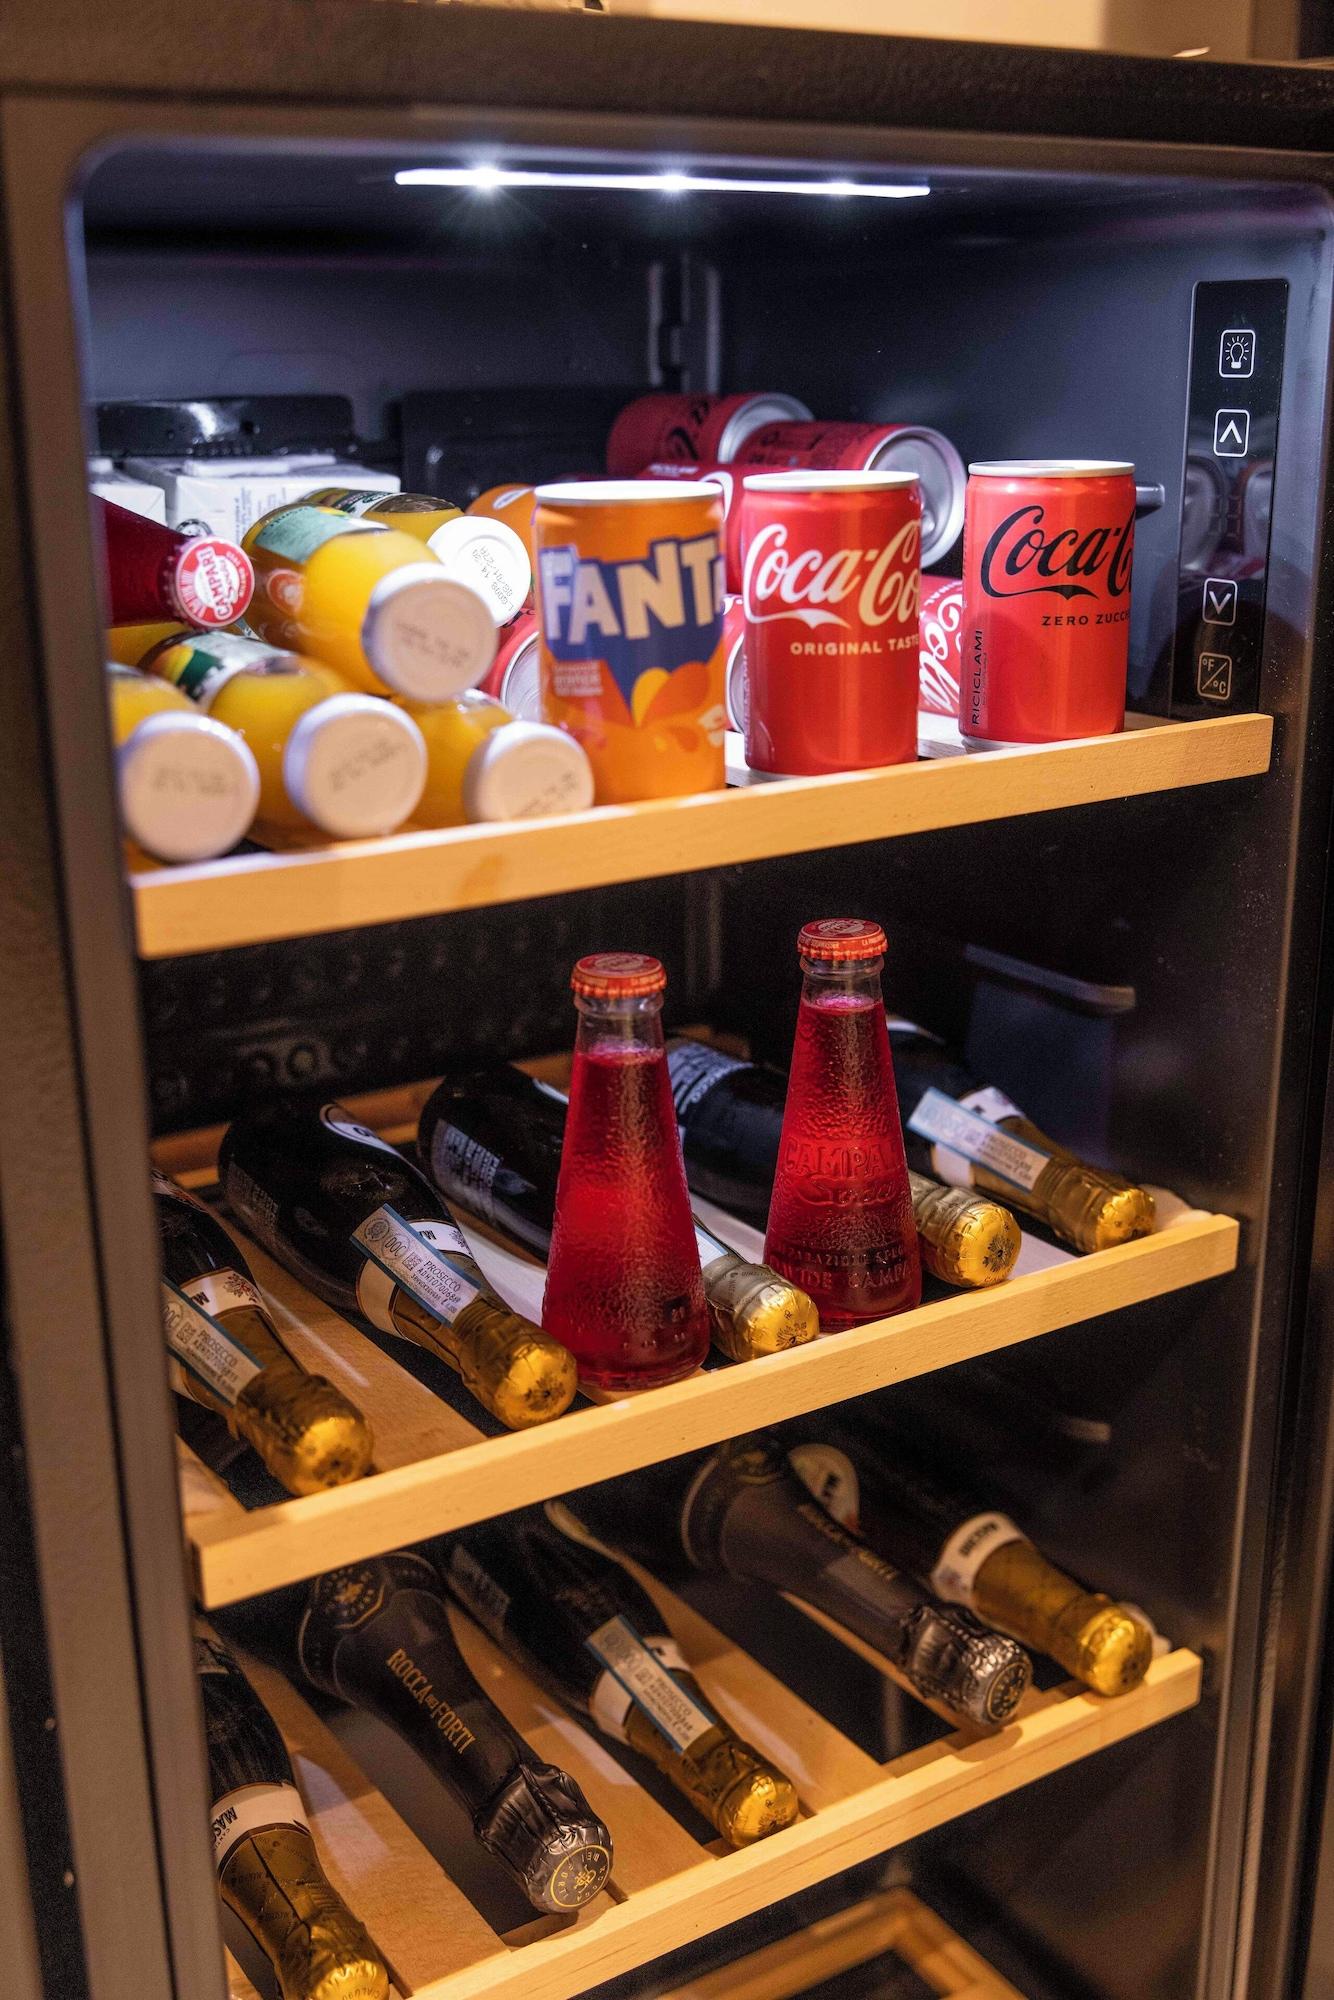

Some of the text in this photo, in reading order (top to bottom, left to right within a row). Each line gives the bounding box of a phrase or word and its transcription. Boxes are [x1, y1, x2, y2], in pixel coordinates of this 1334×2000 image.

[200, 550, 230, 616] CAMPARI
[540, 537, 726, 645] FANT
[1042, 615, 1089, 626] ZERO
[789, 642, 883, 656] ORIGINAL
[972, 630, 982, 725] RICICLAMI
[384, 1236, 407, 1257] DOC
[423, 1260, 461, 1292] PROSECCO
[386, 1648, 433, 1704] ROCCA
[431, 1701, 476, 1754] FORTI
